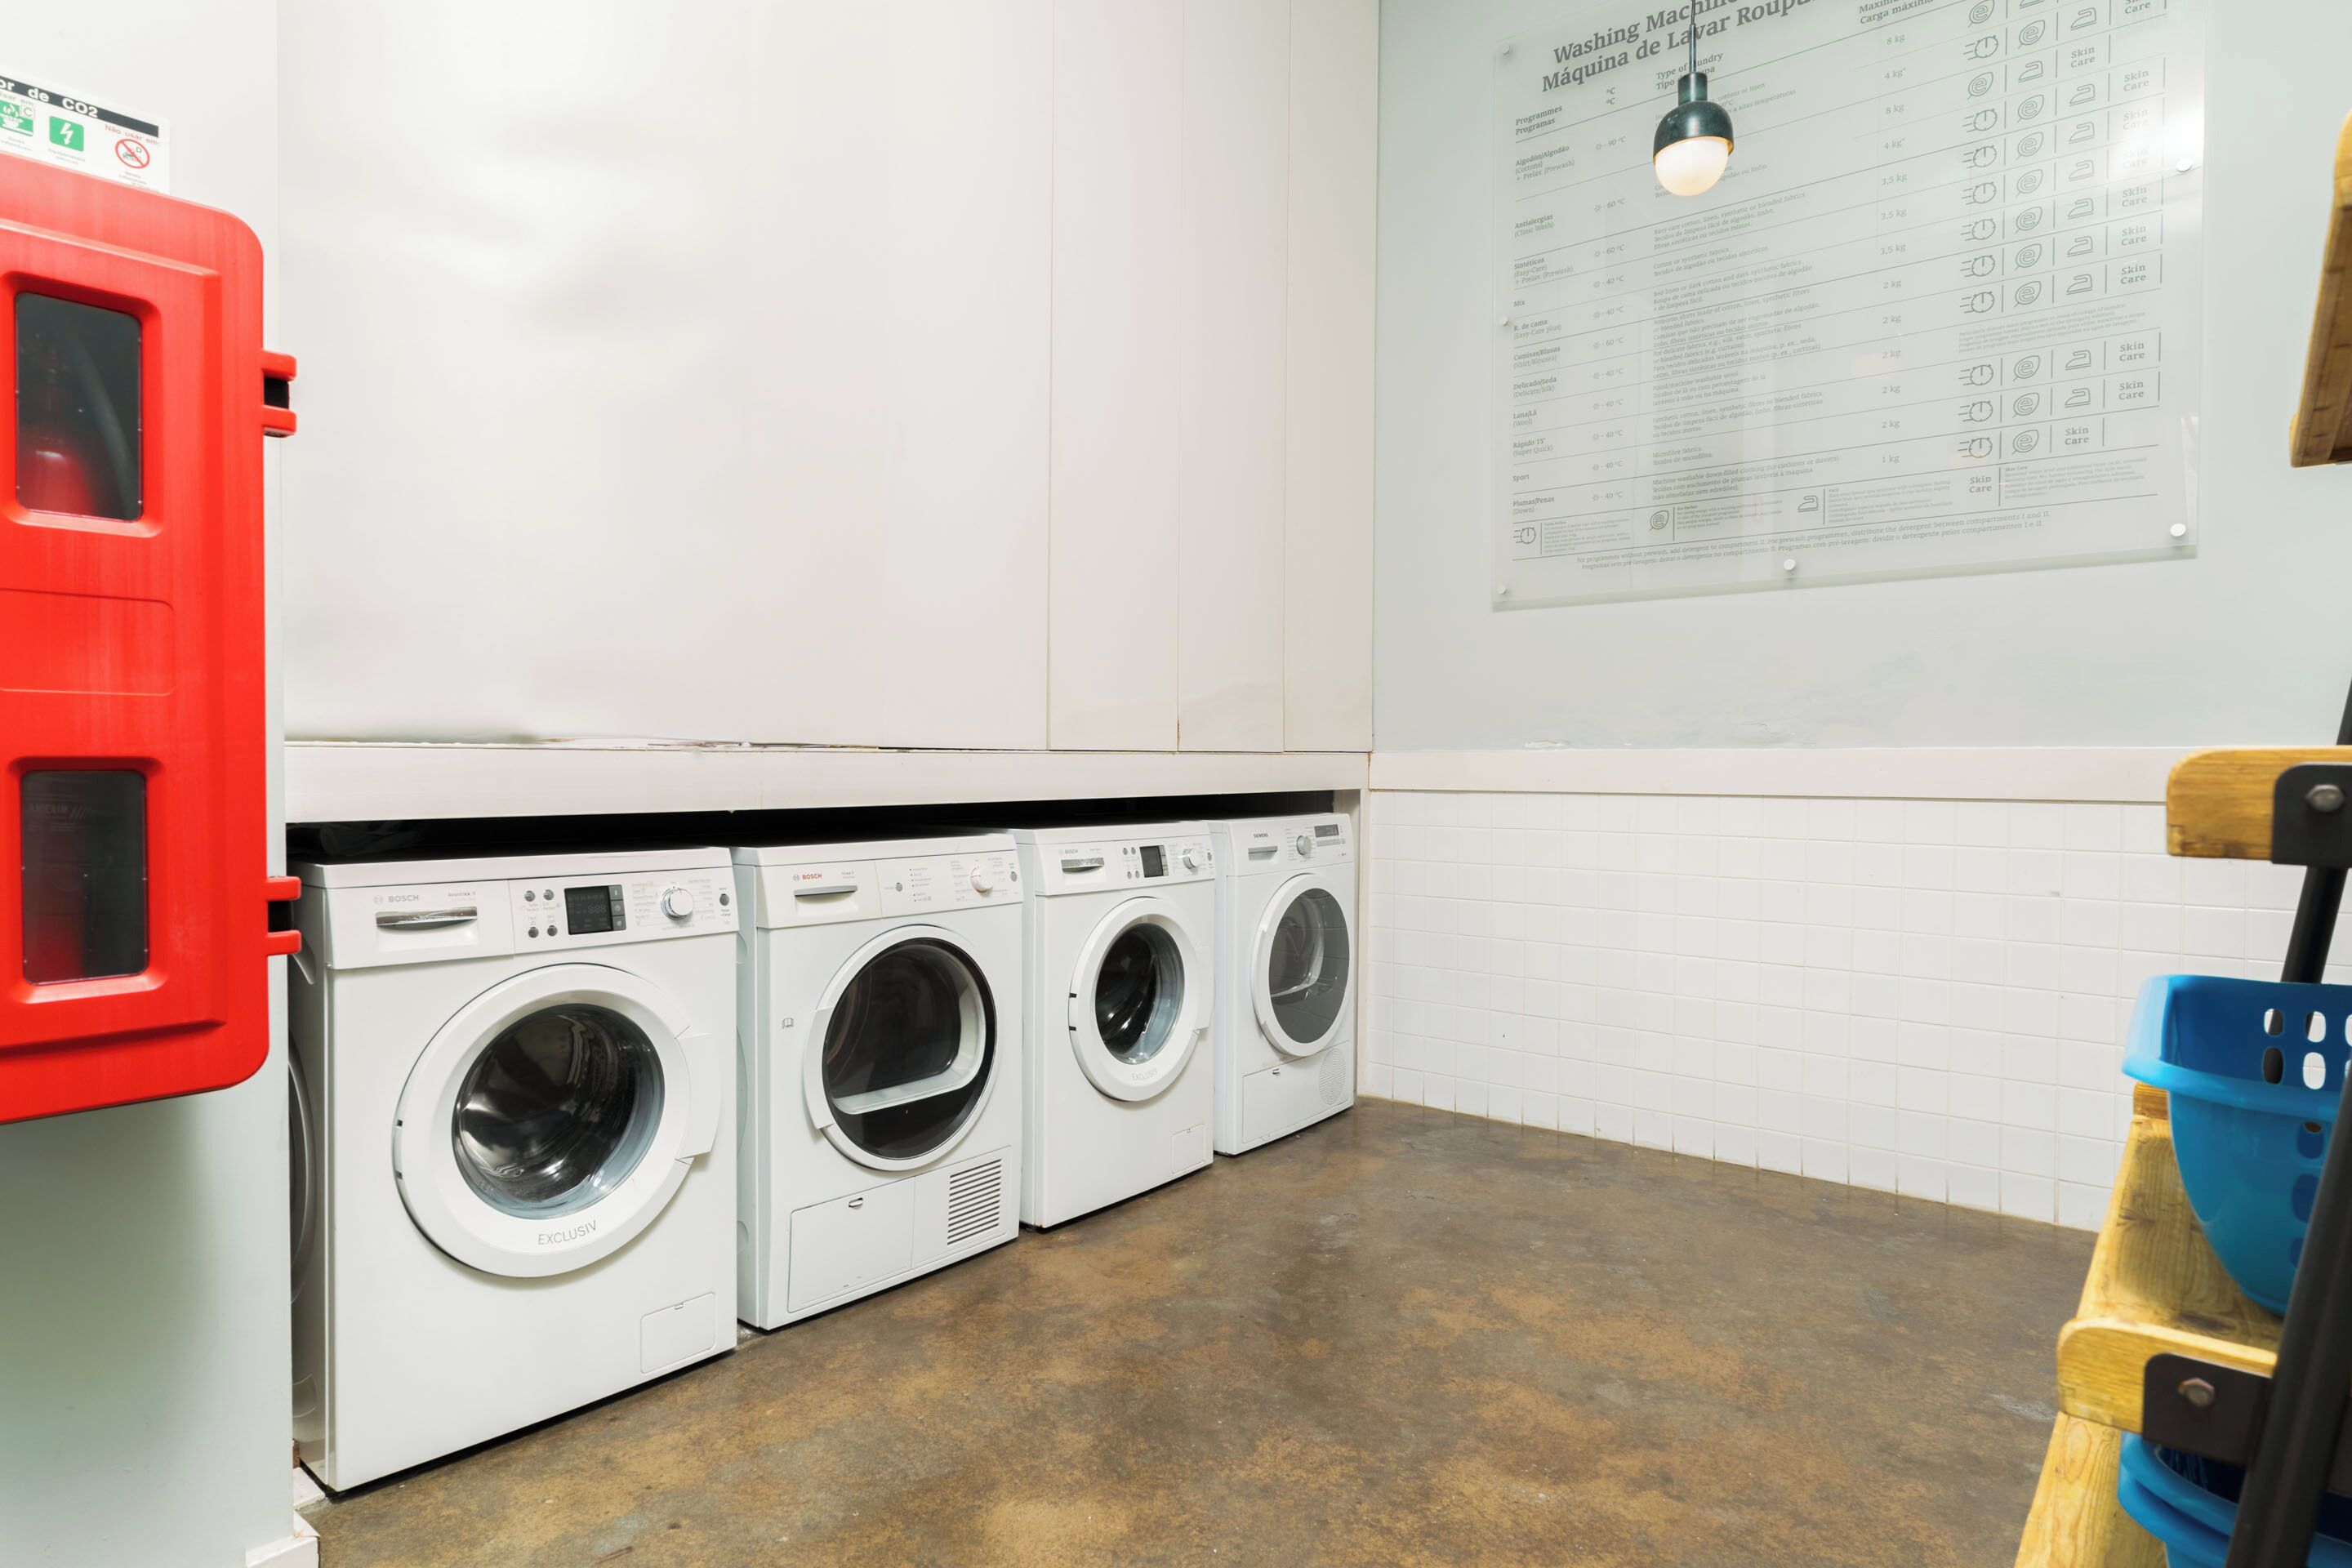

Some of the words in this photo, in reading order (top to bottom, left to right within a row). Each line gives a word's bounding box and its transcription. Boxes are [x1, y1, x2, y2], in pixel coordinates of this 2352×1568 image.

[2125, 0, 2152, 14] Care
[1860, 11, 1889, 24] Carga
[1554, 24, 1639, 63] Washing
[1646, 0, 1738, 33] Machin
[1543, 52, 1628, 91] Máquina
[1636, 41, 1660, 60] de
[1668, 16, 1731, 50] Lavar
[2071, 47, 2095, 59] Skin
[2071, 56, 2095, 68] Care
[1656, 69, 1676, 80] Type
[1678, 63, 1688, 73] of
[2124, 71, 2149, 82] Skin
[1656, 80, 1675, 90] Tipo
[2123, 81, 2149, 91] Care
[28, 87, 49, 103] de
[62, 97, 99, 118] CO2
[1516, 106, 1562, 126] Programmes
[1516, 118, 1555, 135] Programas
[105, 124, 122, 135] Não
[125, 131, 142, 141] usar
[2123, 187, 2147, 198] Skin
[2122, 197, 2147, 207] Care
[1515, 215, 1552, 229] Antialergias
[1514, 227, 1534, 238] (Clinic
[1535, 221, 1553, 231] Wash)
[2122, 225, 2146, 237] Skin
[2121, 236, 2146, 246] Care
[1514, 258, 1544, 270] Sintéticos
[2122, 265, 2145, 275] Skin
[2121, 275, 2146, 284] Care
[2120, 342, 2145, 352] Skin
[1514, 347, 1560, 361] Camisas/Blusas
[2119, 353, 2145, 362] Care
[1513, 377, 1557, 390] Delicado/Seda
[2119, 381, 2144, 390] Skin
[2119, 391, 2144, 400] Care
[1513, 418, 1533, 428] (Wool)
[2065, 427, 2089, 436] Skin
[1513, 440, 1535, 449] Rápido
[1513, 448, 1532, 457] (Super
[1512, 474, 1530, 483] Sport
[1970, 476, 1991, 484] Skin
[1513, 497, 1554, 506] Plumas/Penas
[1512, 506, 1535, 516] (Down)
[388, 894, 419, 902] BOSCH
[537, 1220, 597, 1245] EXCLUSIV
